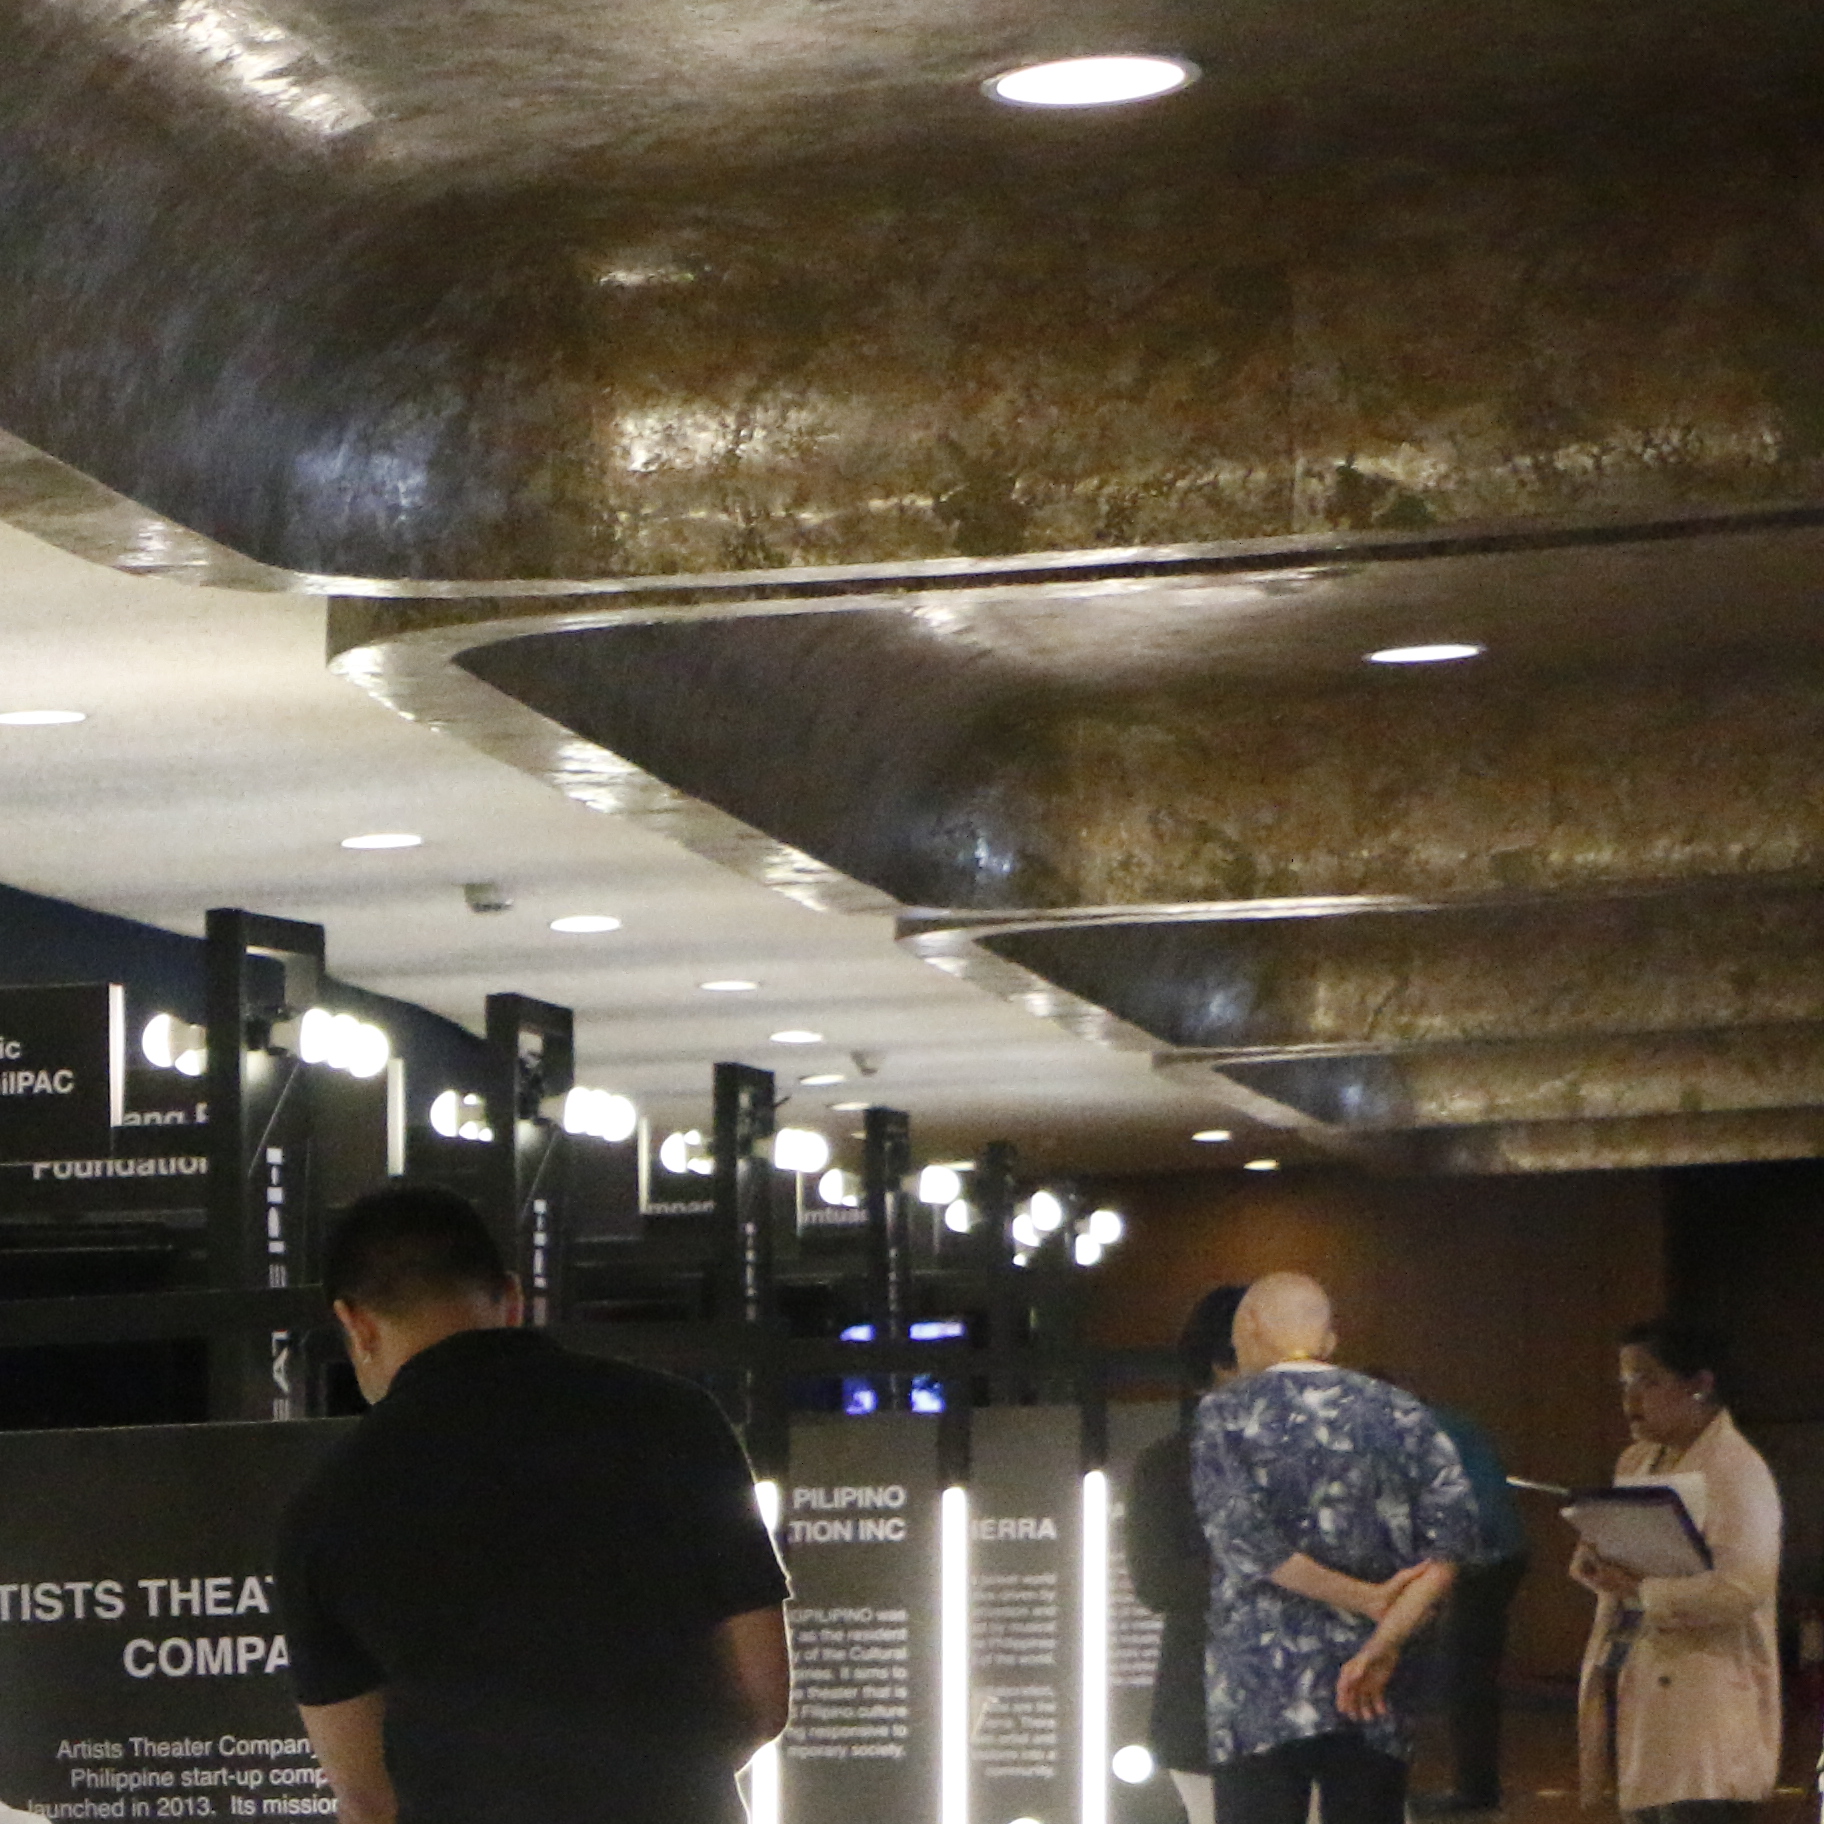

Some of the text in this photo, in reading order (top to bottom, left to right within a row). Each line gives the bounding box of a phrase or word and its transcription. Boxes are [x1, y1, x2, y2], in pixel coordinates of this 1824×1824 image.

[793, 1485, 907, 1510] PILIPINO
[858, 1516, 907, 1542] INC
[137, 1574, 275, 1618] THEA
[122, 1633, 291, 1679] COMPA
[56, 1735, 320, 1760] Artists Theater Compan
[70, 1768, 174, 1792] Philippine
[180, 1766, 263, 1789] start-up
[131, 1798, 150, 1818] in
[156, 1796, 217, 1817] 2013.
[230, 1795, 256, 1815] Its
